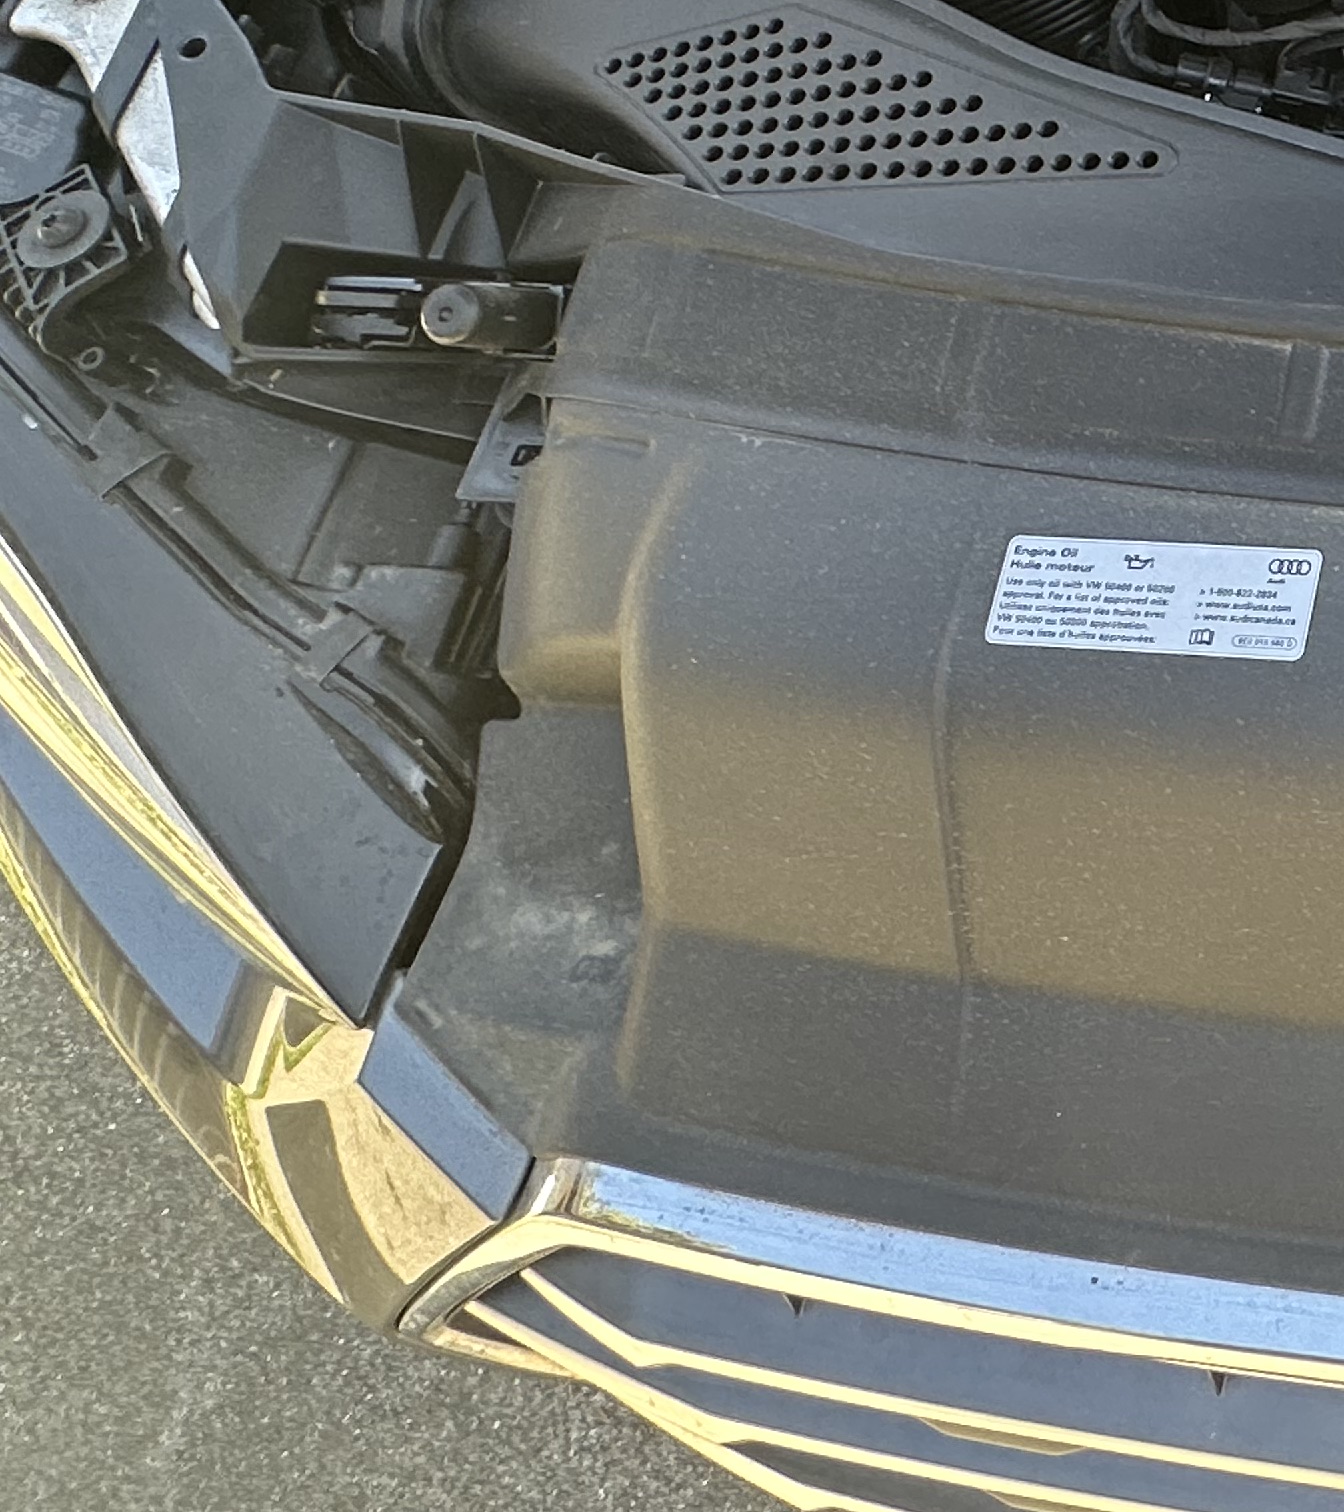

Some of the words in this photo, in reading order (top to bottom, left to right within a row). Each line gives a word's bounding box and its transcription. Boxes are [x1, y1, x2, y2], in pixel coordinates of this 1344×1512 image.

[1014, 545, 1057, 558] Engine
[1061, 547, 1079, 558] Oil
[1010, 559, 1042, 570] Huile
[1045, 563, 1095, 573] moteur
[1006, 577, 1023, 586] Use
[1026, 578, 1046, 588] only
[1048, 579, 1060, 588] oil
[1063, 579, 1083, 589] with
[1086, 581, 1103, 590] VW
[1075, 593, 1089, 602] list
[1091, 593, 1101, 603] of
[1103, 595, 1148, 605] approved
[997, 614, 1015, 622] VW
